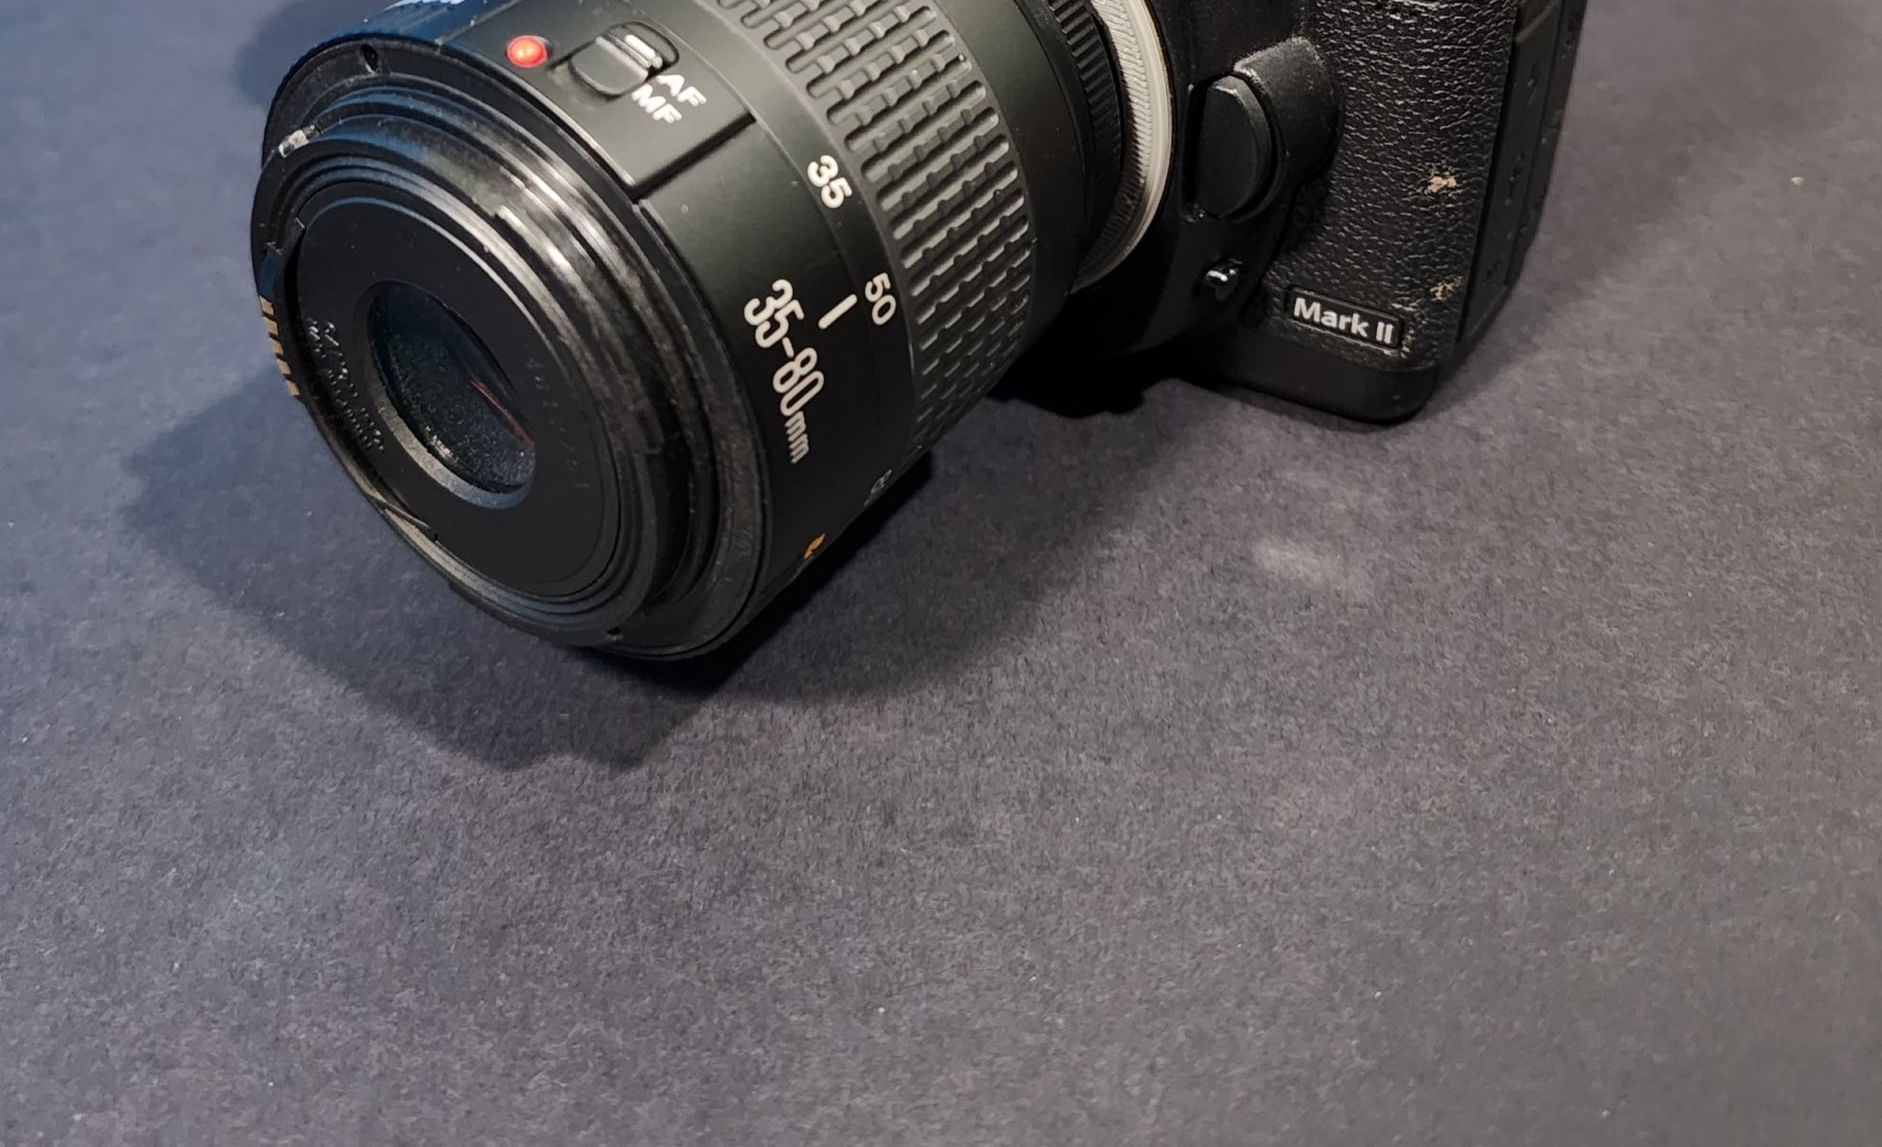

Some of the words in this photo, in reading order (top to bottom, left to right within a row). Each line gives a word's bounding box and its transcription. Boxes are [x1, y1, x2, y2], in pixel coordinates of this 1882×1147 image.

[631, 83, 683, 124] MF
[656, 74, 707, 107] AF
[807, 155, 853, 209] 35
[865, 272, 896, 325] 50
[1293, 297, 1369, 338] Mark
